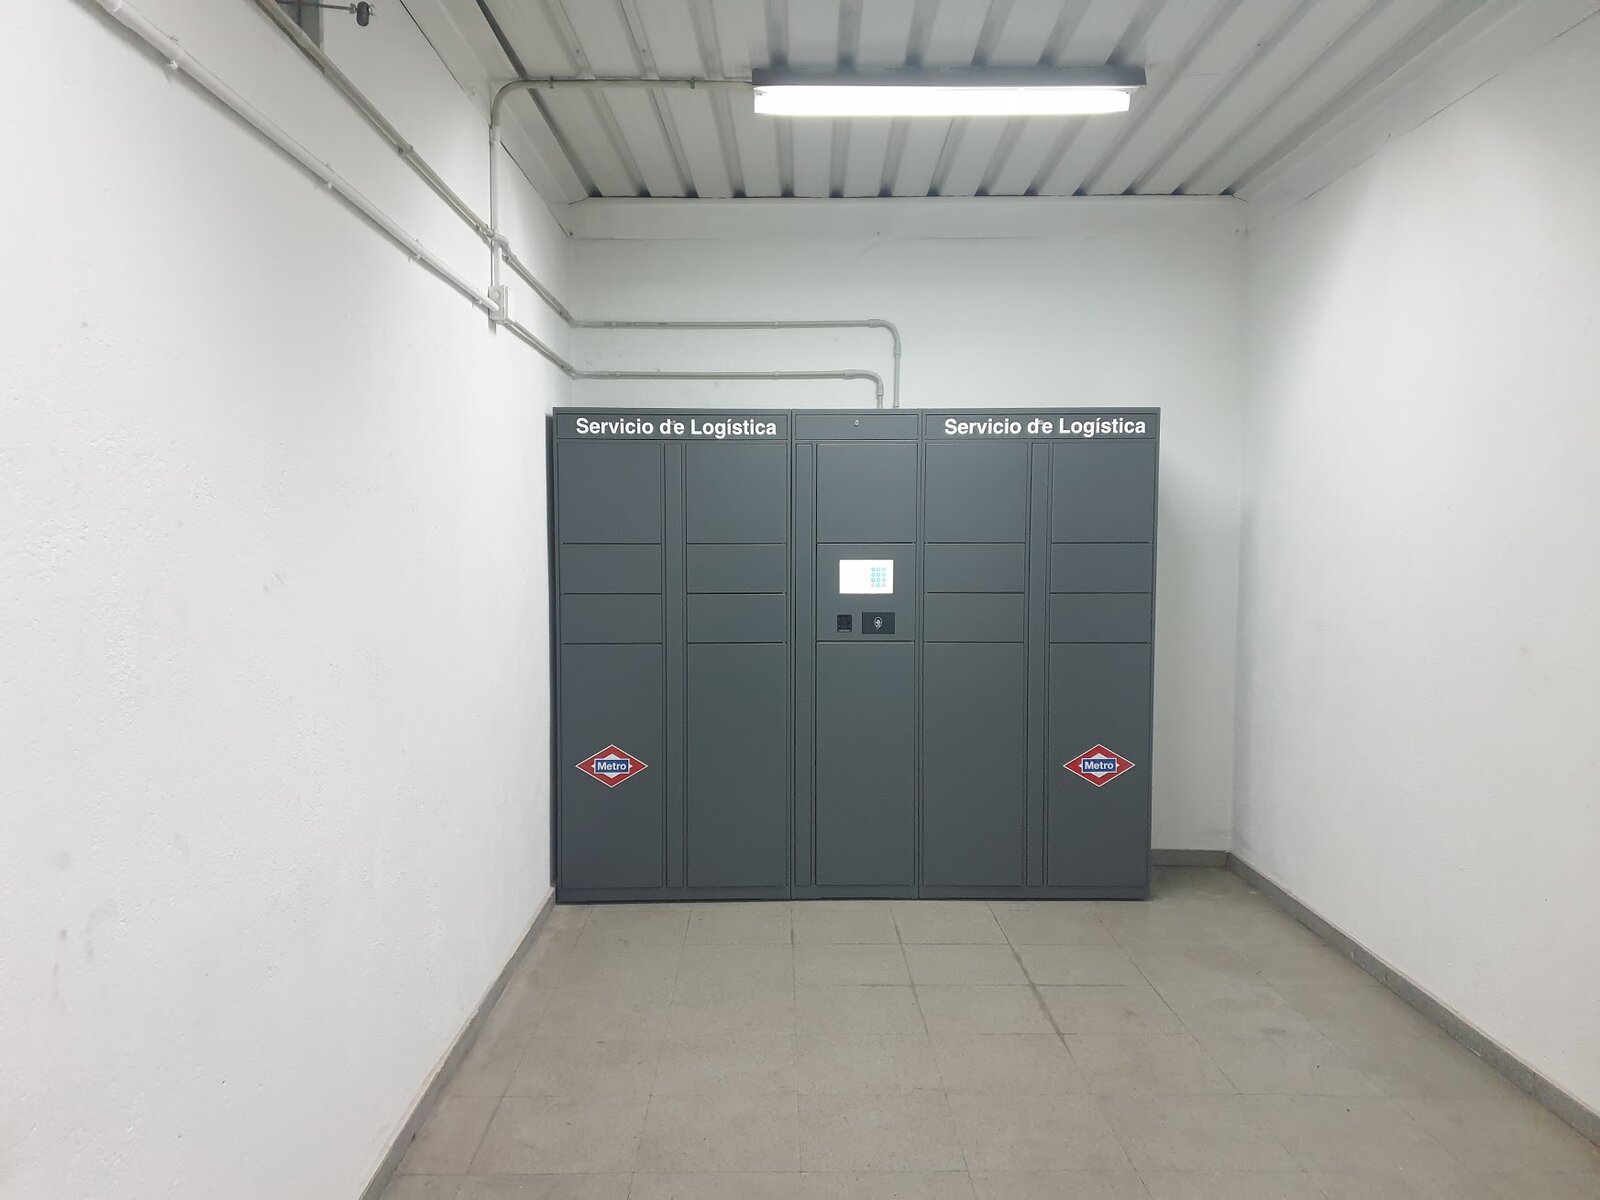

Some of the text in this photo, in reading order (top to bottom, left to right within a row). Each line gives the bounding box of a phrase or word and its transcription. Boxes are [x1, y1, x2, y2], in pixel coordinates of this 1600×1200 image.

[576, 417, 777, 439] Servicio de Logística
[944, 417, 1146, 438] Servicio de Logística
[597, 761, 627, 771] Metro
[1084, 761, 1114, 770] Metro
